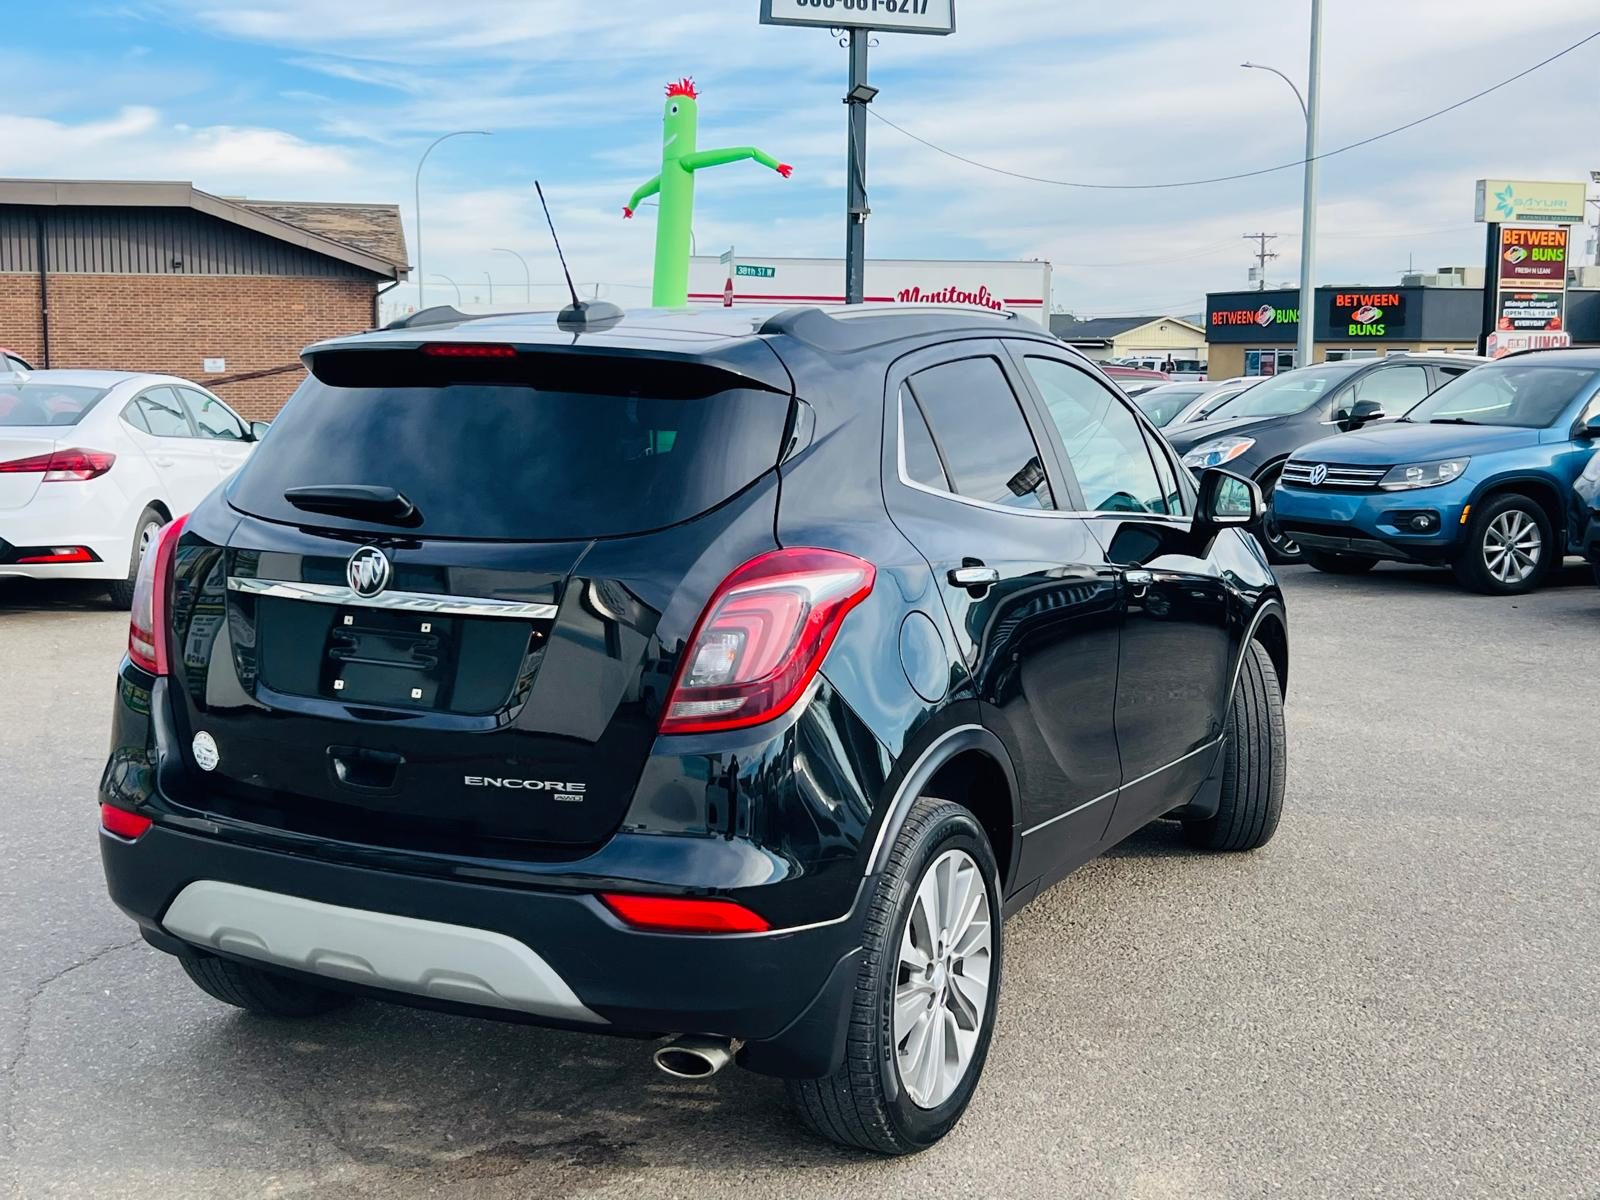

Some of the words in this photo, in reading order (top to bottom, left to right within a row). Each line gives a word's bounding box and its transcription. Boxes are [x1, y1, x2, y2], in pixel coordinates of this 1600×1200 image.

[1503, 230, 1565, 246] BETWEEN
[1532, 248, 1564, 261] BUNS
[898, 285, 1002, 310] Manitoulin
[1336, 294, 1399, 307] BETWEEN
[1212, 310, 1254, 325] BETWEEN
[1349, 324, 1385, 336] BUNS
[464, 776, 586, 792] ENCORE
